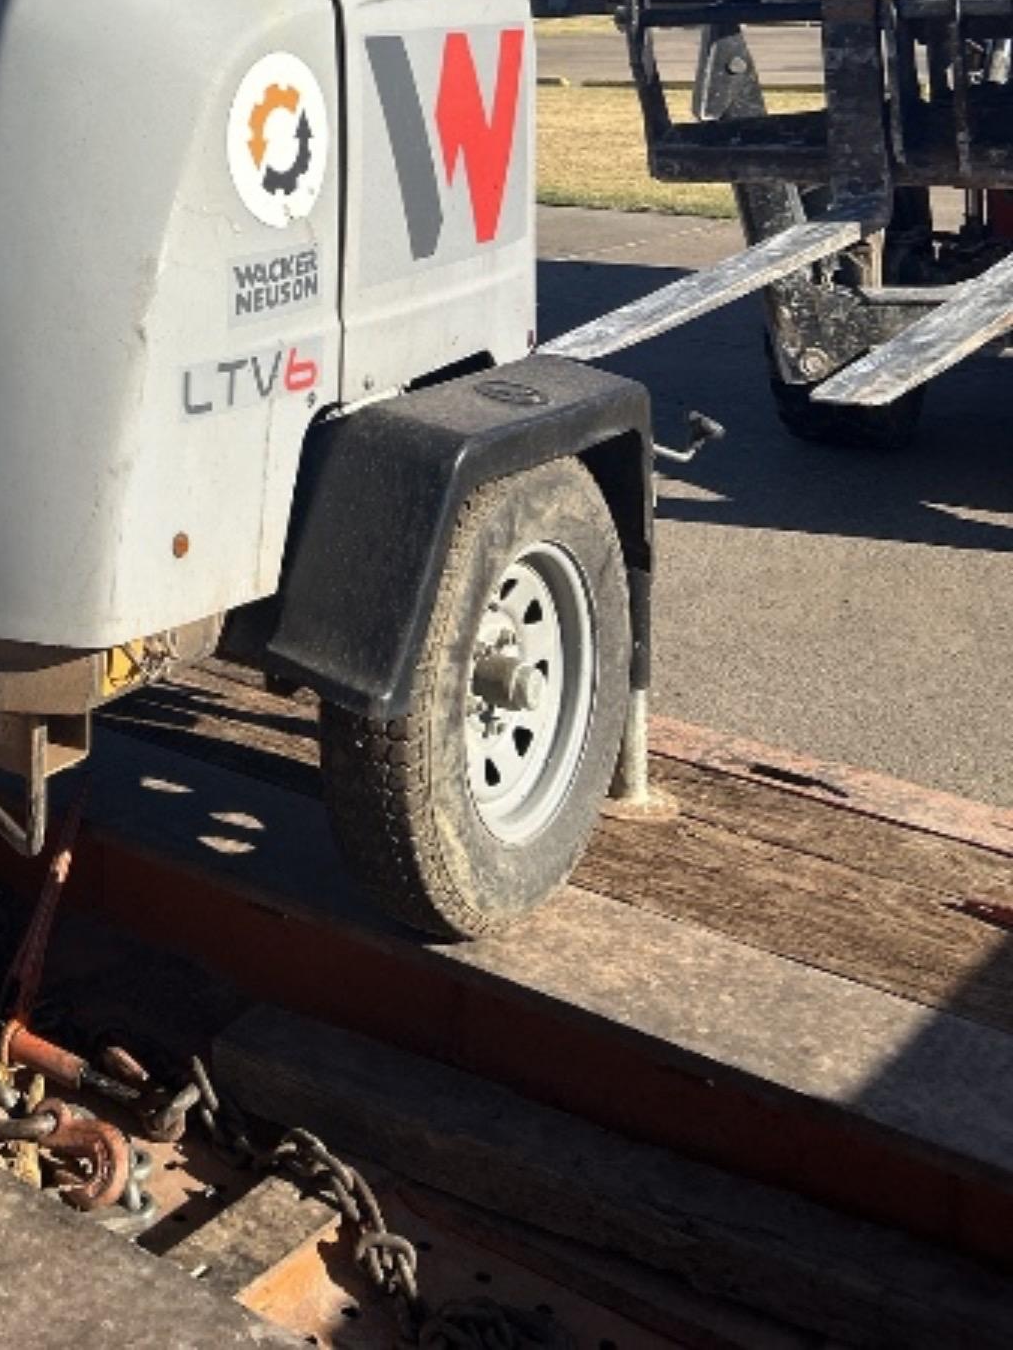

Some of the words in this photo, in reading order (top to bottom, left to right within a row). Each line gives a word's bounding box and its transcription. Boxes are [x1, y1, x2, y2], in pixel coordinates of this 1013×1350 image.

[233, 249, 318, 289] WACKER
[235, 273, 318, 316] NEUSON
[183, 347, 317, 415] LTV6
